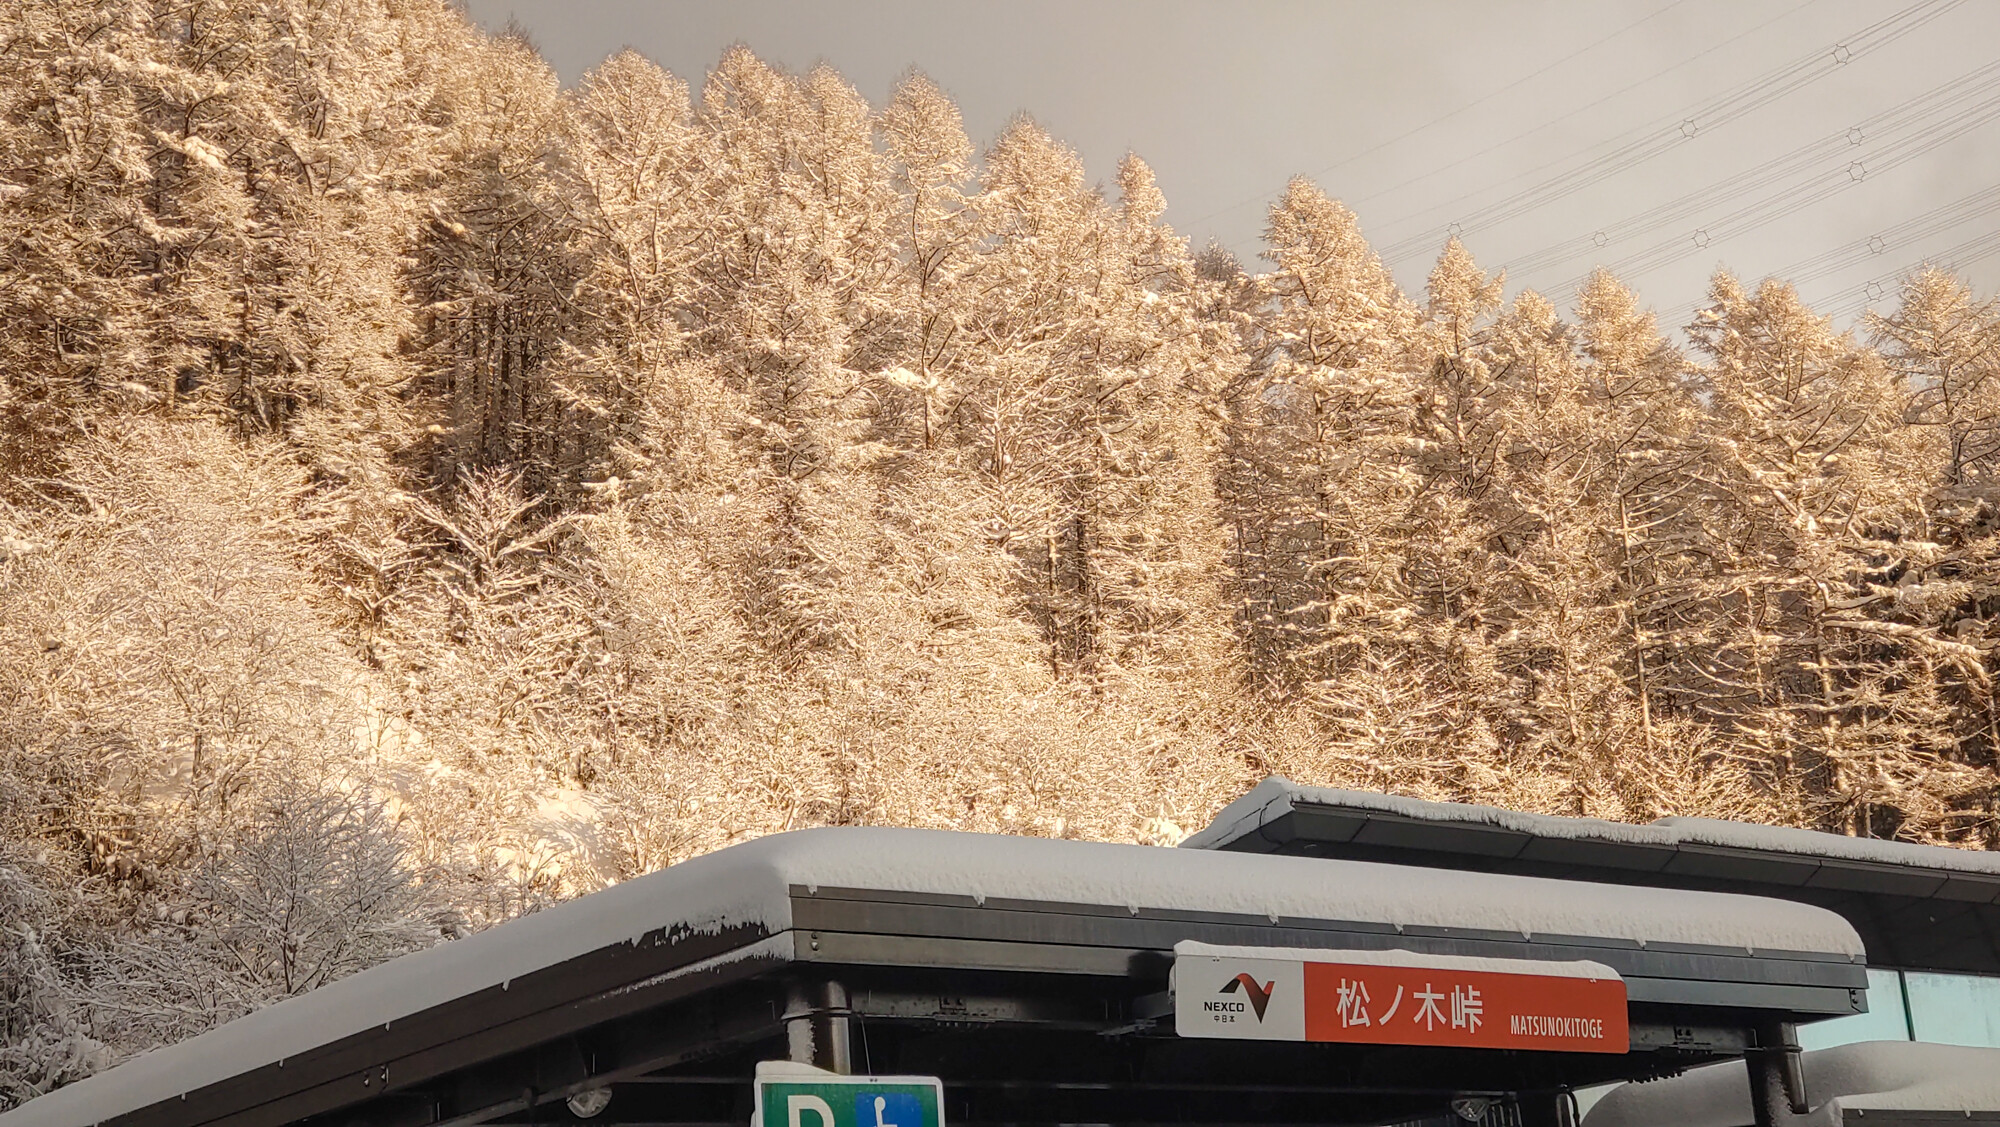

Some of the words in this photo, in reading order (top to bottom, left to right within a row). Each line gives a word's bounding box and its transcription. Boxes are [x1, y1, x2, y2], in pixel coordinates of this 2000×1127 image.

[1204, 1002, 1245, 1012] NEXCO
[1336, 978, 1483, 1033] 松ノ木峠
[1511, 1015, 1604, 1039] MATSUNOKITOGE
